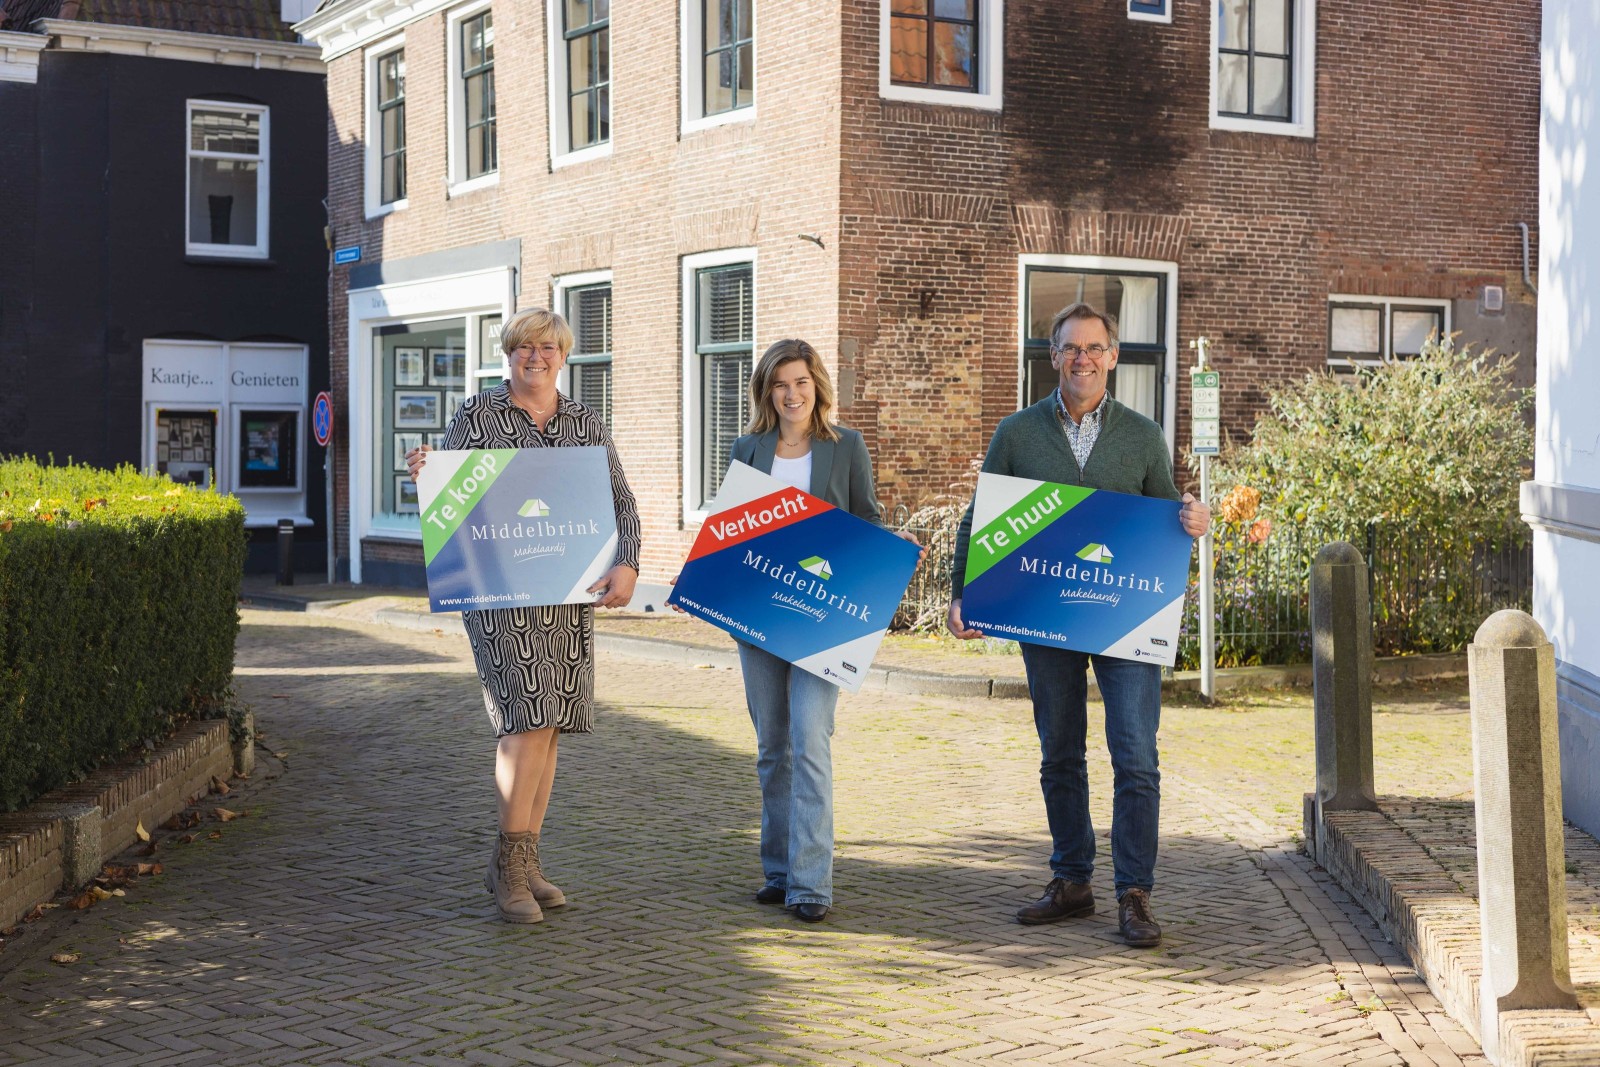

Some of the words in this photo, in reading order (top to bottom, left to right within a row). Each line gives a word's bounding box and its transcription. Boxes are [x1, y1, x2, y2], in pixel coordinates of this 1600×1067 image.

[231, 370, 299, 387] Genieten
[426, 504, 457, 530] Te
[448, 453, 497, 506] koop
[471, 519, 600, 541] Middelbrink
[709, 493, 808, 541] Verkocht
[976, 529, 1009, 555] Te
[1006, 486, 1063, 536] huur
[513, 542, 566, 559] Makelaardij
[742, 549, 872, 622] Middelbrink
[1019, 556, 1165, 594] Middelbrink
[439, 592, 531, 606] www.middelbrink.info
[771, 591, 829, 622] Makelaardij
[1059, 588, 1121, 607] Makelaardij
[679, 595, 766, 642] www.middelbrink.info
[968, 619, 1067, 642] www.middelbrink.info
